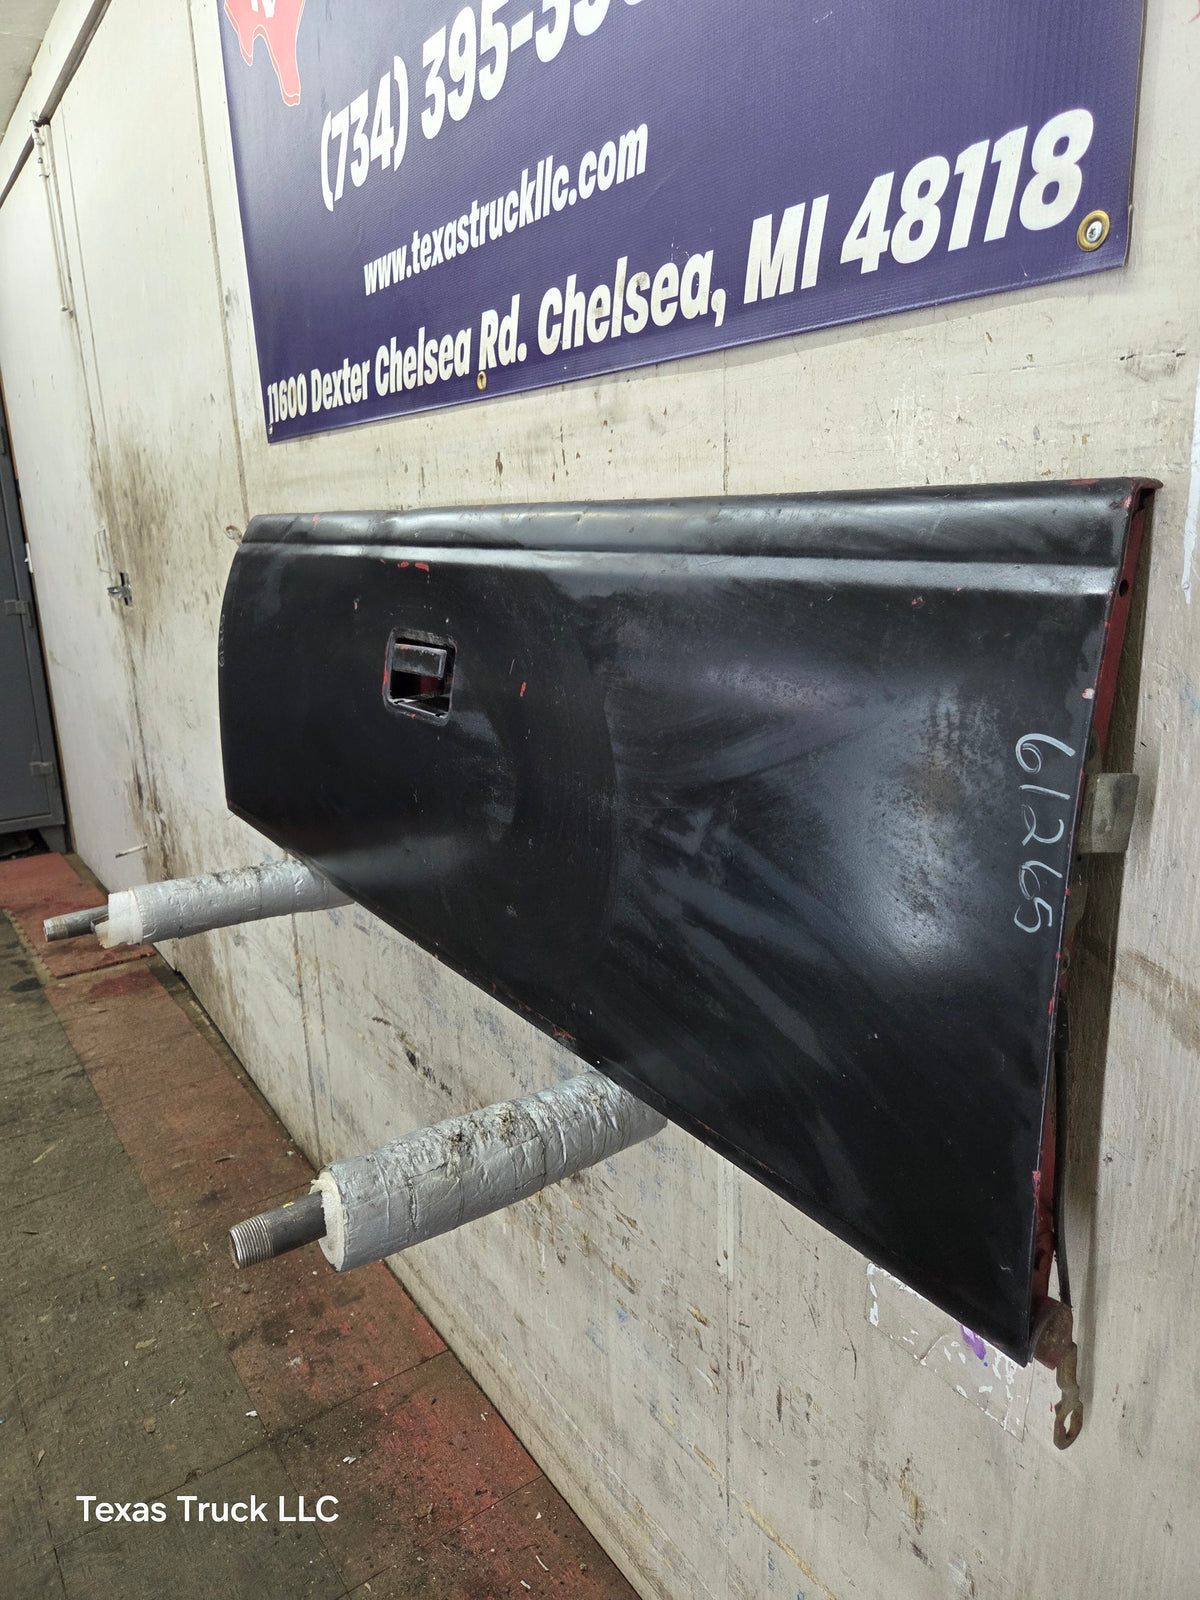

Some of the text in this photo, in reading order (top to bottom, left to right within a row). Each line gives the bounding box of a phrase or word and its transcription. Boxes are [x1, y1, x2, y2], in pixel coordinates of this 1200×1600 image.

[320, 56, 408, 211] (734)
[364, 124, 648, 295] www.texastruckllc.com
[267, 109, 1094, 425] 11600 Dexter Chelsea Rd. Chelsea, MI 48118
[1014, 733, 1076, 933] 61265
